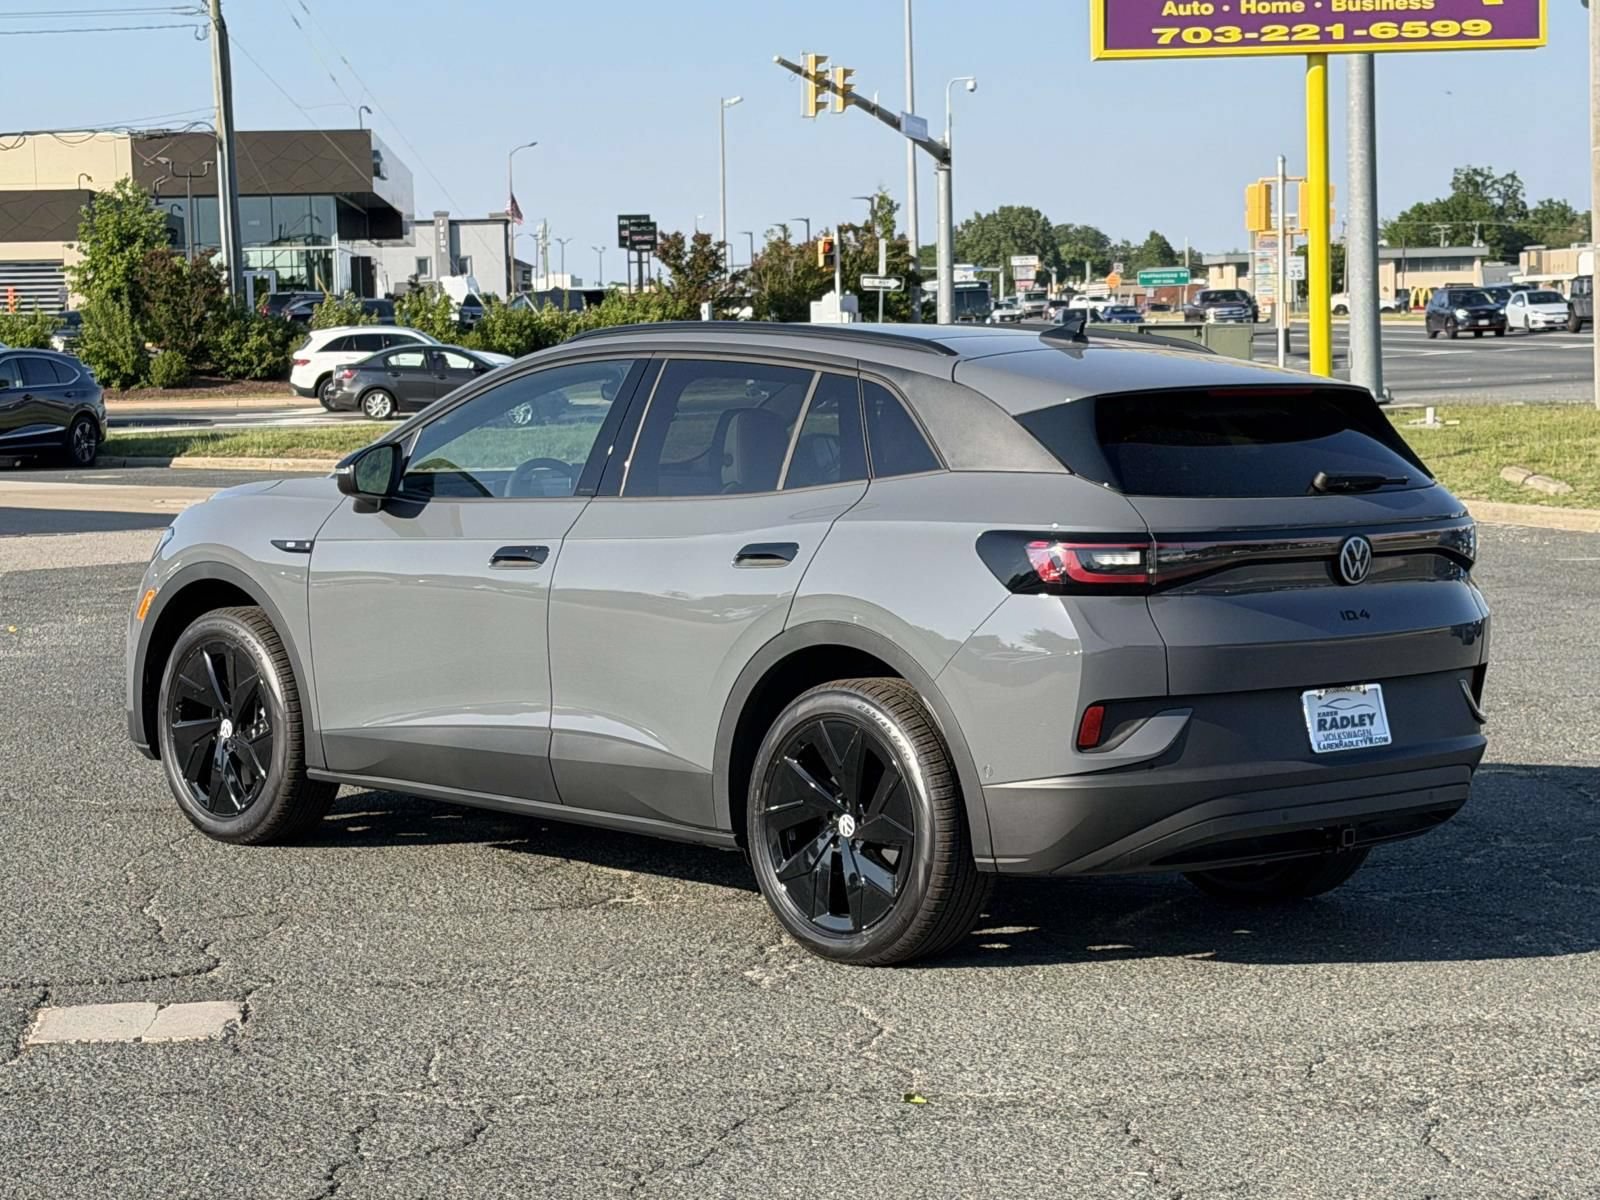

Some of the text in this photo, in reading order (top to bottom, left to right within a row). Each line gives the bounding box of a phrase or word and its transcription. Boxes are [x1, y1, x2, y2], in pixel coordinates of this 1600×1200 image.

[1161, 0, 1435, 17] Auto Home Business
[1151, 18, 1494, 45] 703-221-6599
[1316, 710, 1339, 718] KAREN
[1317, 712, 1377, 732] RADLEY
[1322, 728, 1373, 742] VOLKSWAGEN
